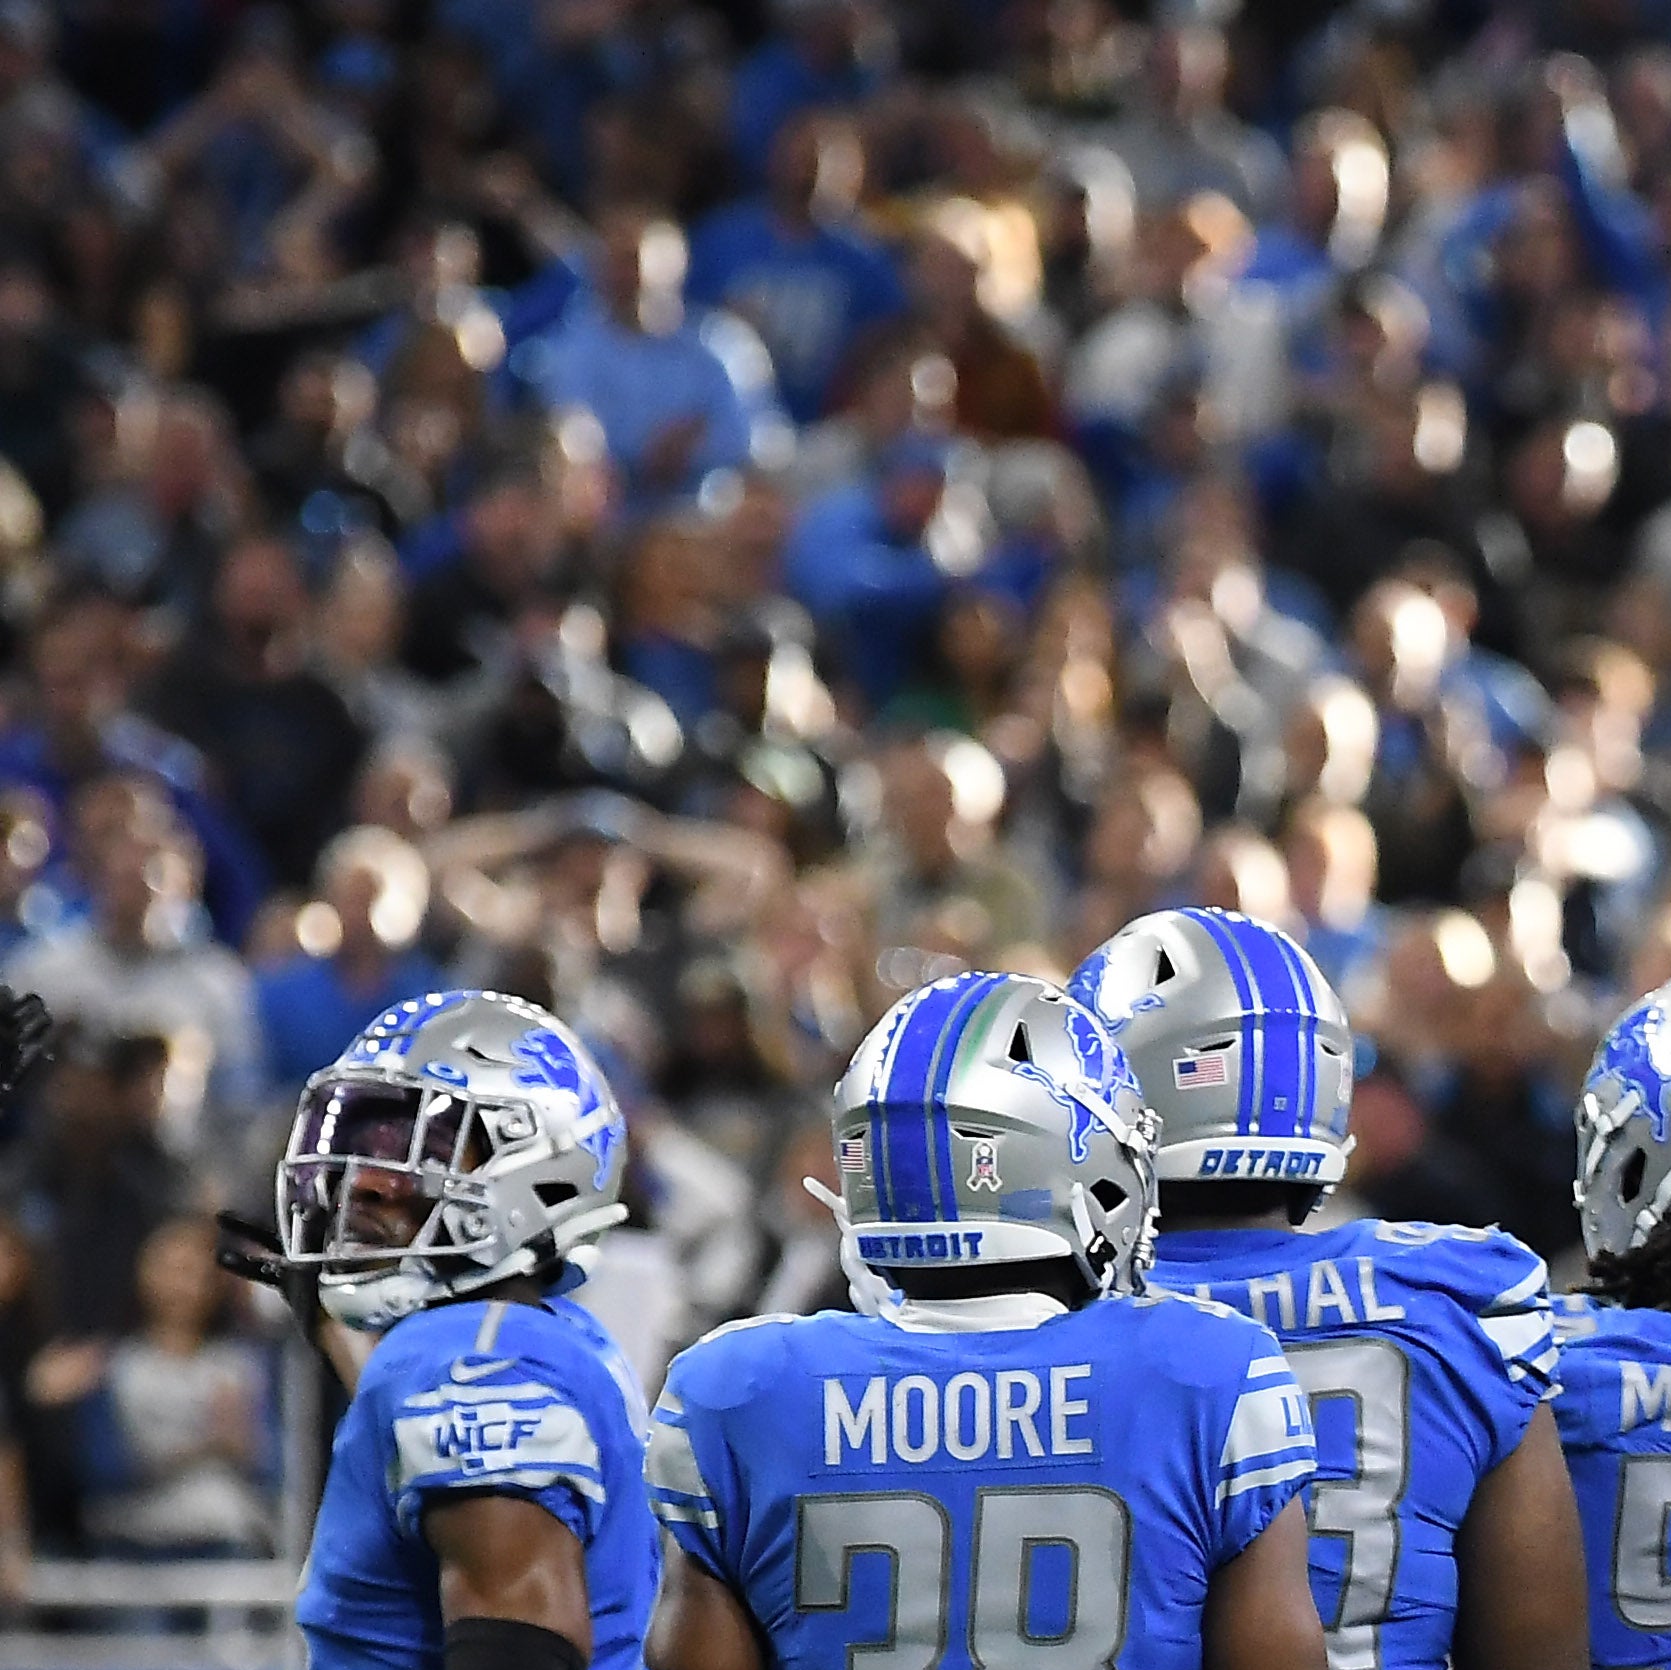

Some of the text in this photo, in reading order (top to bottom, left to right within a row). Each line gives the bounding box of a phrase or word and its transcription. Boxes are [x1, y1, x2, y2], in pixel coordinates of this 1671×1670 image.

[1200, 1150, 1327, 1177] DETROIT
[857, 1231, 984, 1259] DETROIT
[821, 1363, 1095, 1467] MOORE
[434, 1416, 542, 1458] WCF
